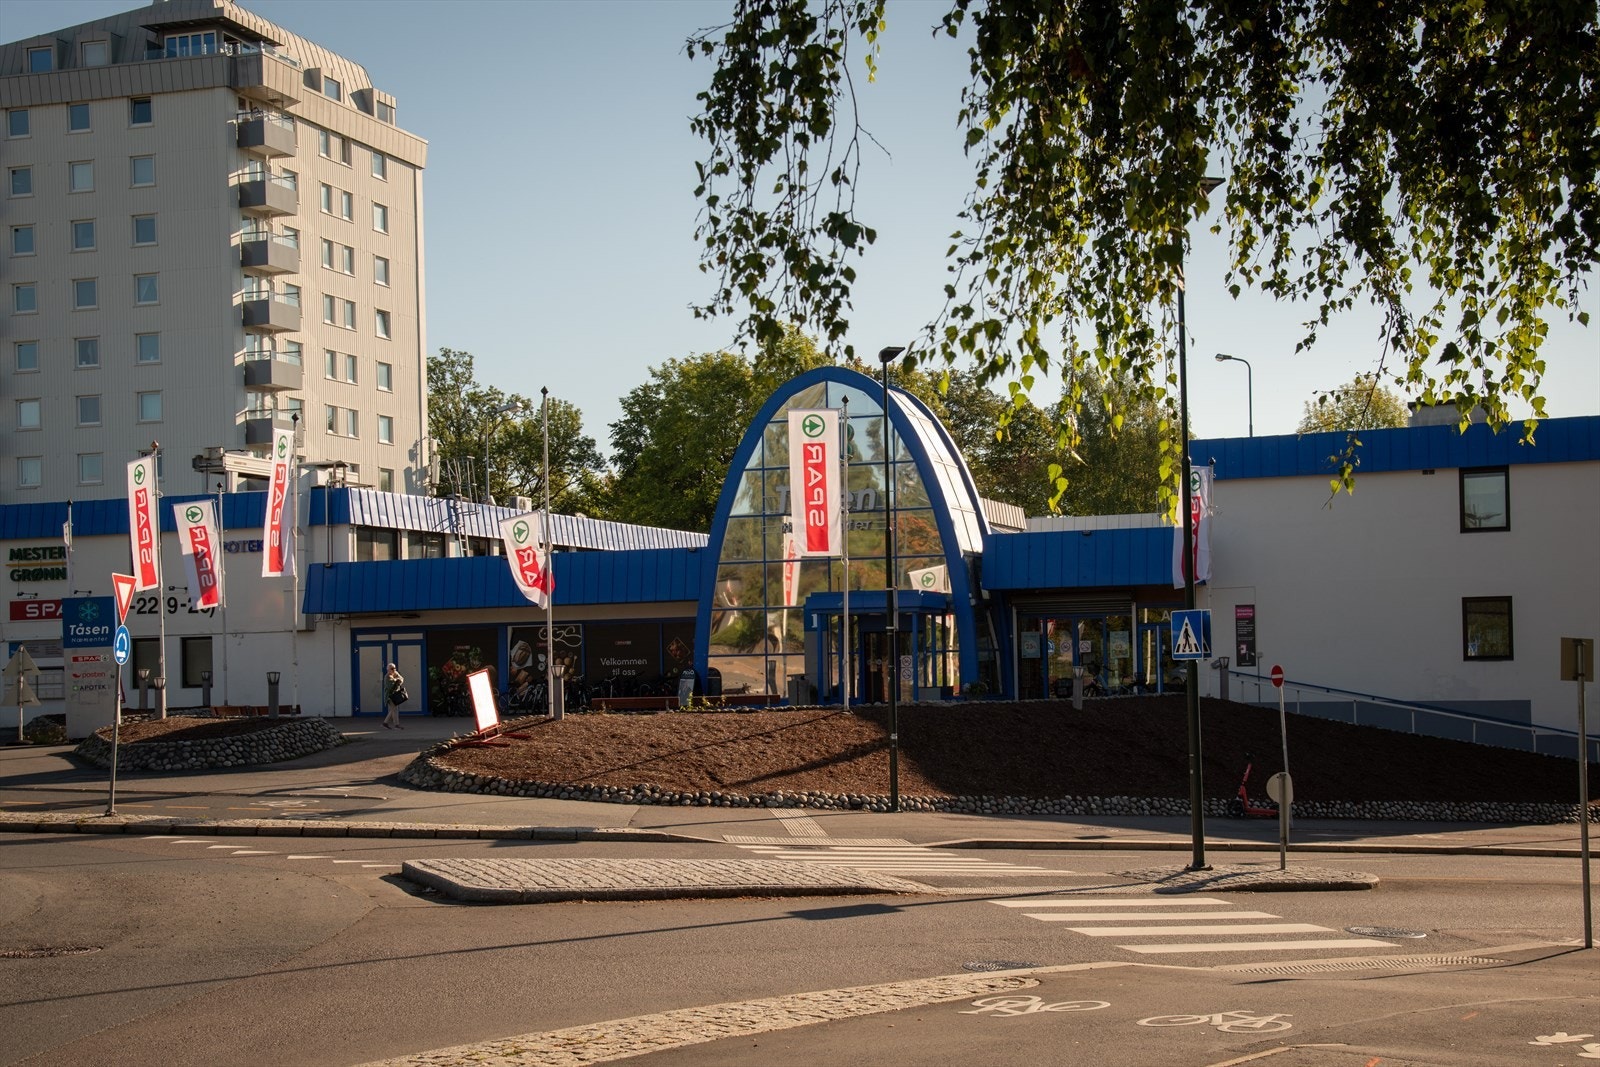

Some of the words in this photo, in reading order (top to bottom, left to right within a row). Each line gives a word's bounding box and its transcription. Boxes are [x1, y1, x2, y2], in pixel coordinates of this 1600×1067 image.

[9, 546, 67, 561] MESTER
[10, 567, 67, 582] GRØNN
[69, 622, 109, 637] Tåsen
[600, 657, 648, 667] Velkommen
[81, 671, 106, 680] posten
[612, 668, 621, 676] til
[79, 684, 107, 692] APOTEK
